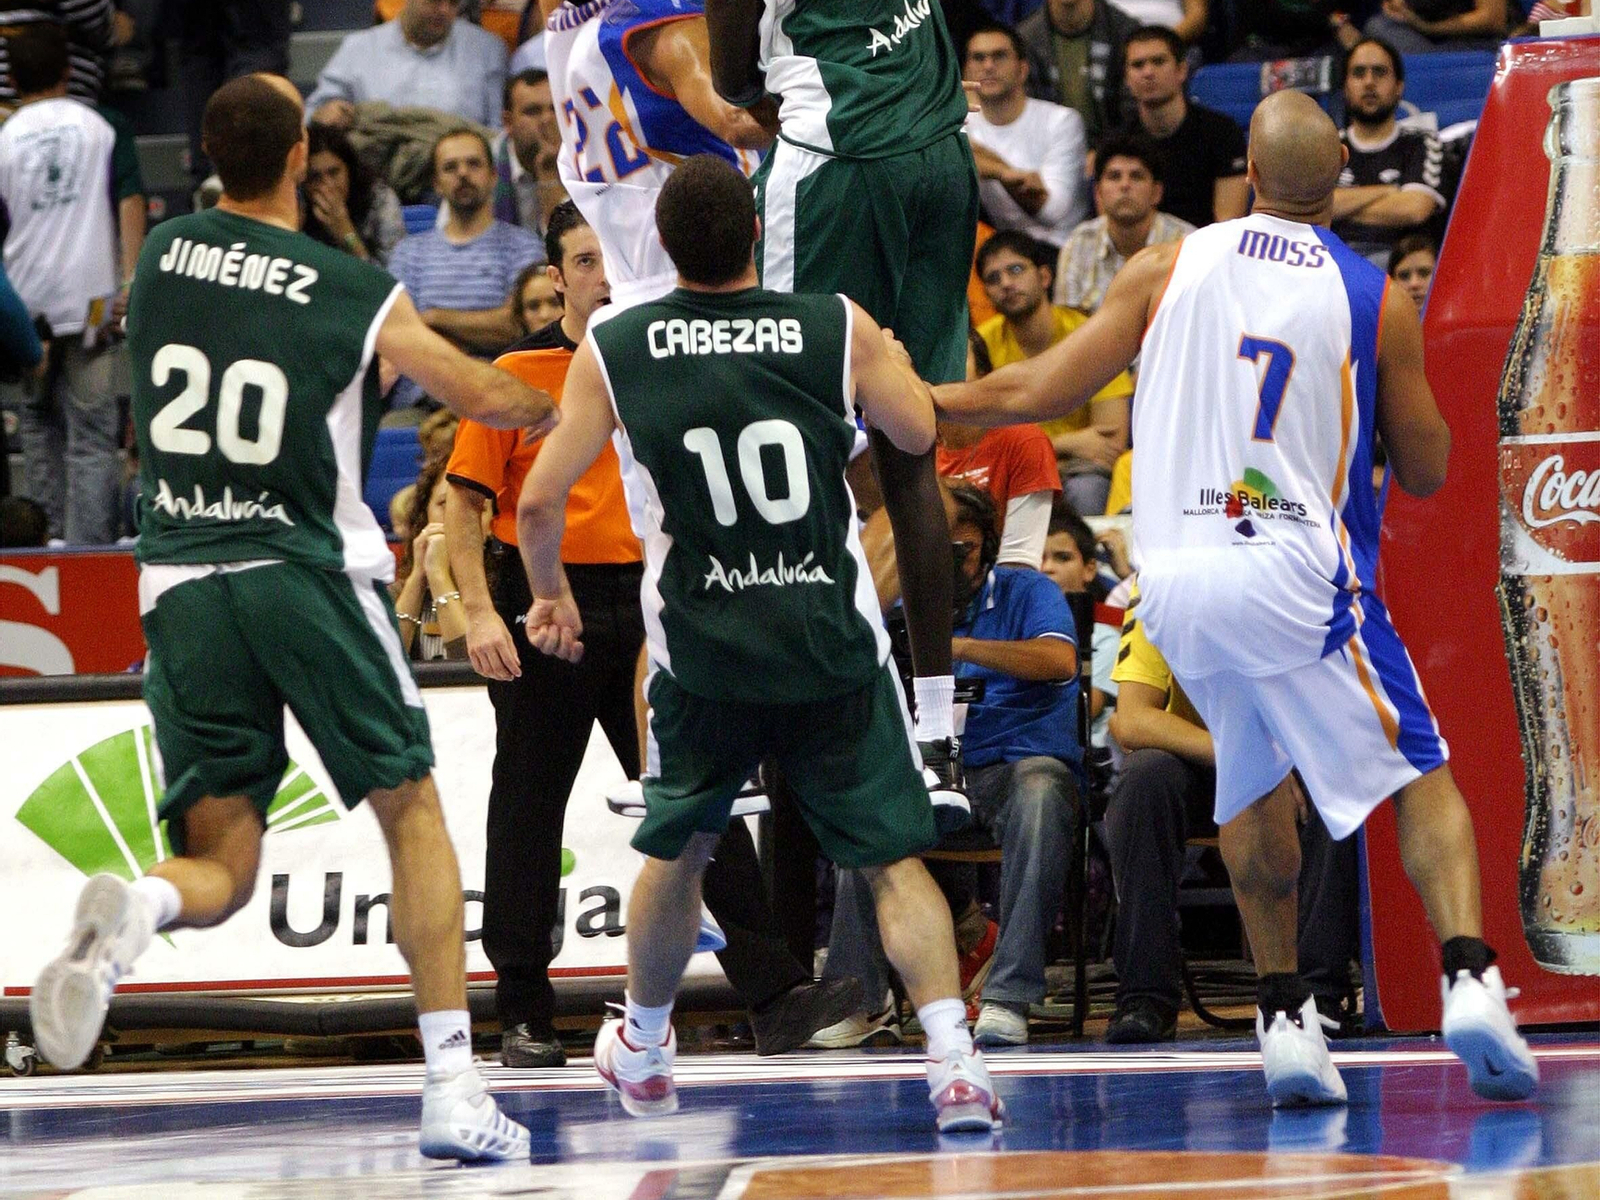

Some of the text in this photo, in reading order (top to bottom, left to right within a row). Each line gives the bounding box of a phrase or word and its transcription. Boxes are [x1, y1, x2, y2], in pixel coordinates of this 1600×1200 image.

[160, 237, 319, 304] JIMÉNEZ
[1237, 229, 1329, 269] MOSS
[647, 318, 803, 359] CABEZAS
[150, 343, 289, 466] 20
[1236, 332, 1297, 444] 7
[683, 419, 811, 527] 10
[1200, 488, 1308, 517] Illes Balears
[269, 848, 627, 961] Unja
